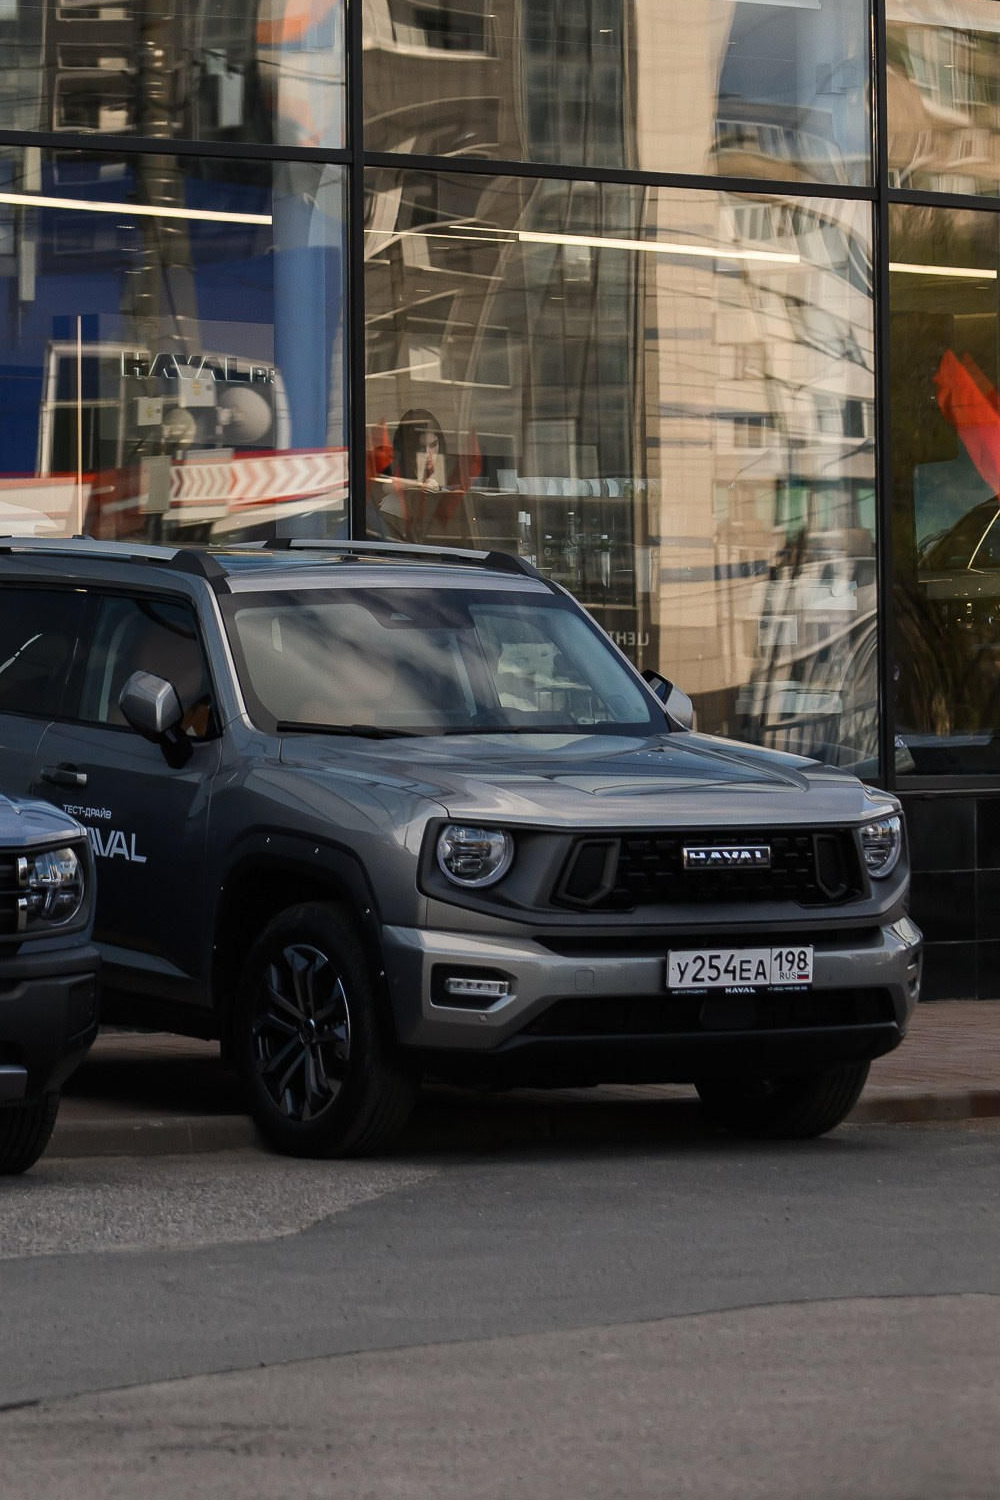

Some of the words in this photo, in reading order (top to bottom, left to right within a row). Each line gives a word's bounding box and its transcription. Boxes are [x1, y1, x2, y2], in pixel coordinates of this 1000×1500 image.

[121, 351, 247, 382] HAVAL
[63, 804, 112, 819] ТЕСТ-ДРАЙВ
[87, 827, 147, 862] AVAL
[689, 851, 768, 864] HAVAL
[676, 953, 767, 983] У254ЕА
[773, 950, 808, 972] 198
[779, 971, 797, 980] RUS
